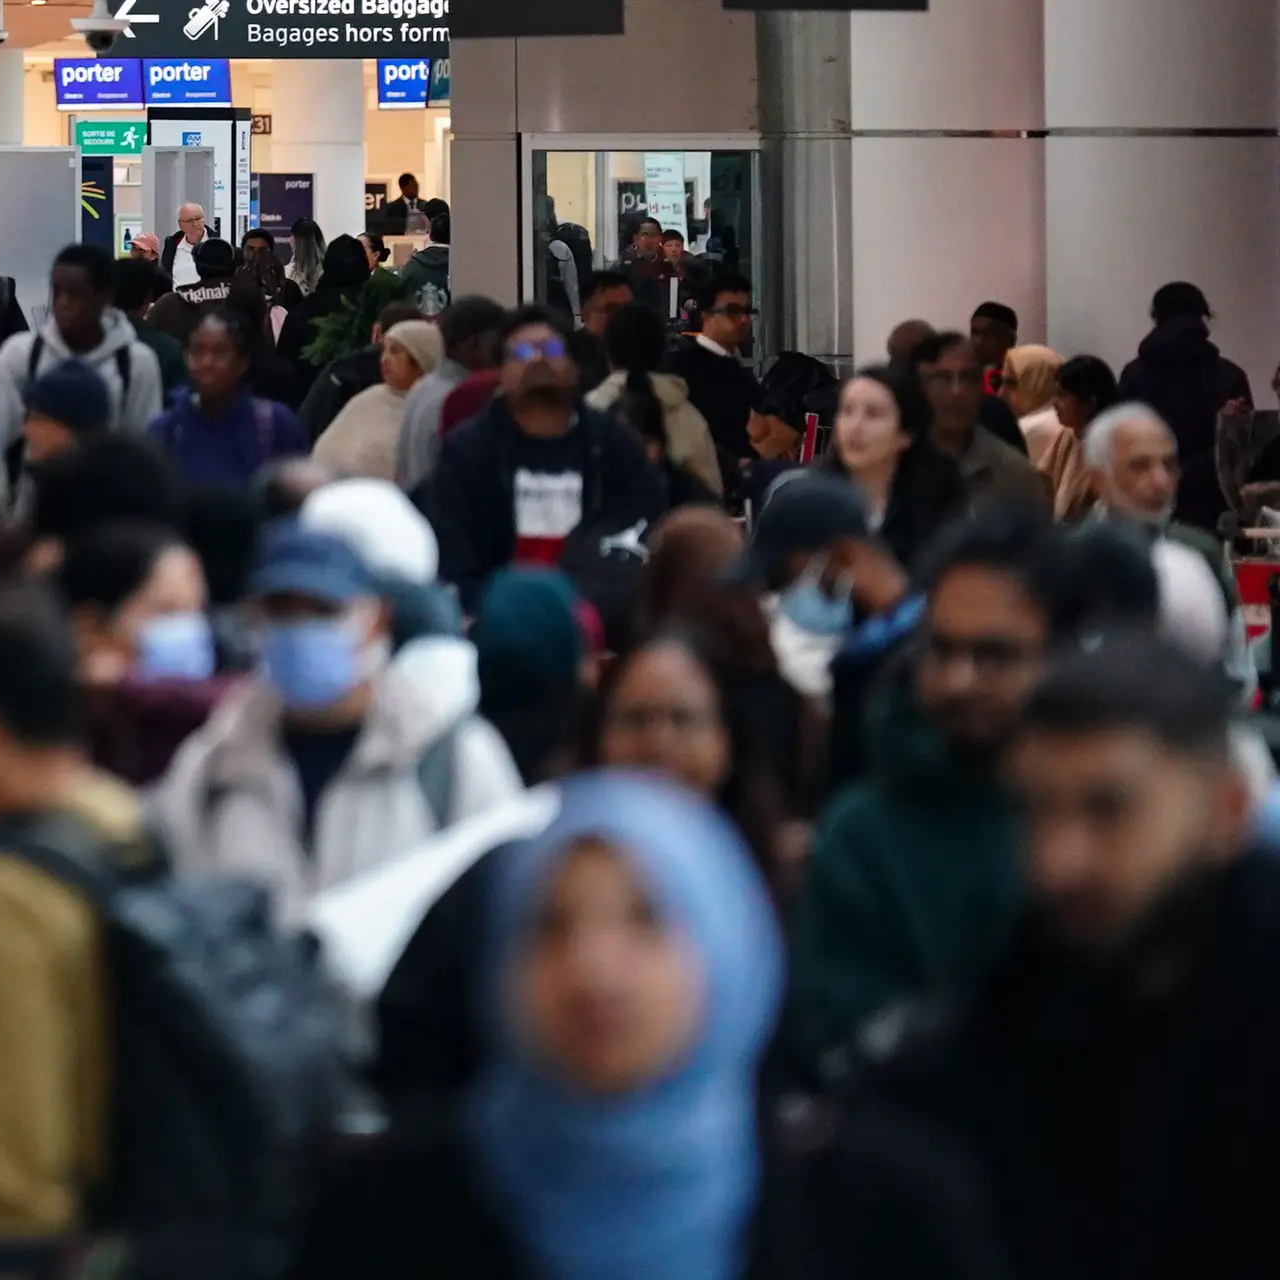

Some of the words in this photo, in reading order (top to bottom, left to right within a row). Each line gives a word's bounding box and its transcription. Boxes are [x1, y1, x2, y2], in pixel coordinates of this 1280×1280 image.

[247, 23, 339, 47] Bagages
[345, 23, 394, 42] hors
[400, 23, 450, 42] form
[61, 63, 123, 86] porter
[149, 62, 211, 86] porter
[385, 60, 429, 84] port
[251, 117, 271, 132] 31
[285, 179, 310, 191] porter
